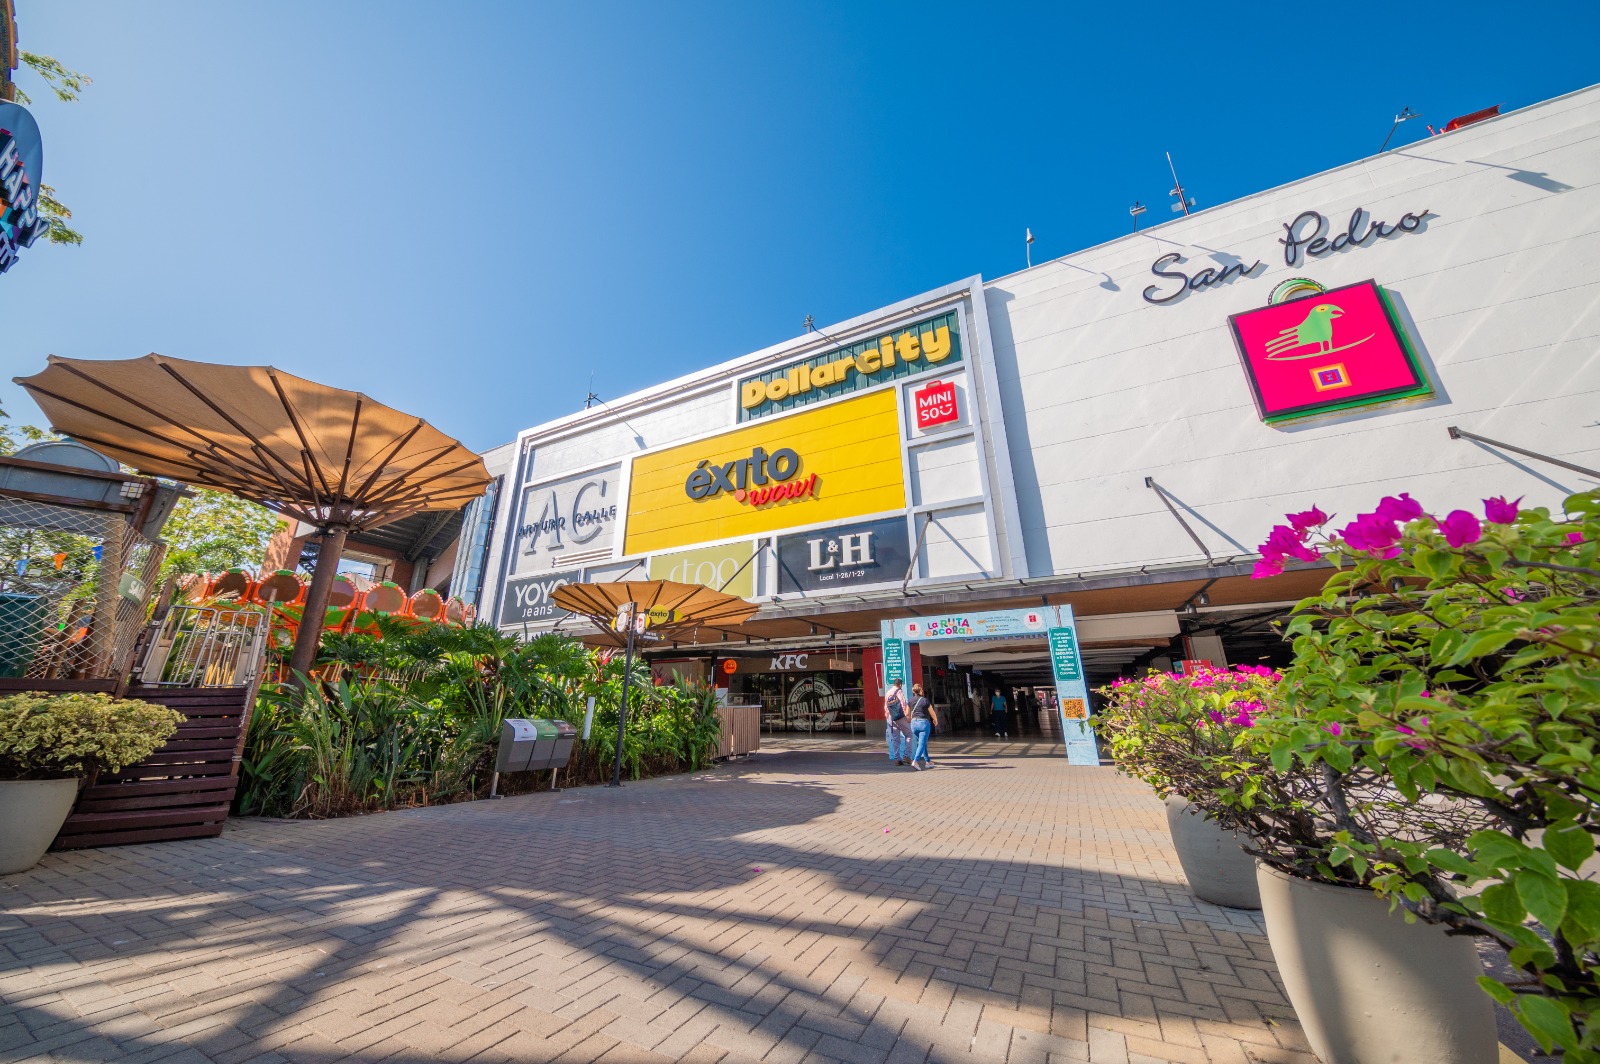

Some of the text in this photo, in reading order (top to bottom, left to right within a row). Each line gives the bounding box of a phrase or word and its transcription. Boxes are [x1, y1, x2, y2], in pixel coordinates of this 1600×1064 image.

[0, 138, 49, 249] HAPPY
[1142, 207, 1429, 304] San Pedro
[742, 326, 952, 409] Dollarcity
[919, 390, 952, 409] MINI
[685, 447, 799, 501] éxito
[749, 473, 817, 507] wow!
[518, 504, 617, 537] ARTURO CALLE
[523, 478, 608, 556] AC
[807, 531, 875, 570] L&H
[940, 617, 970, 628] RUTA
[769, 654, 809, 670] KFC
